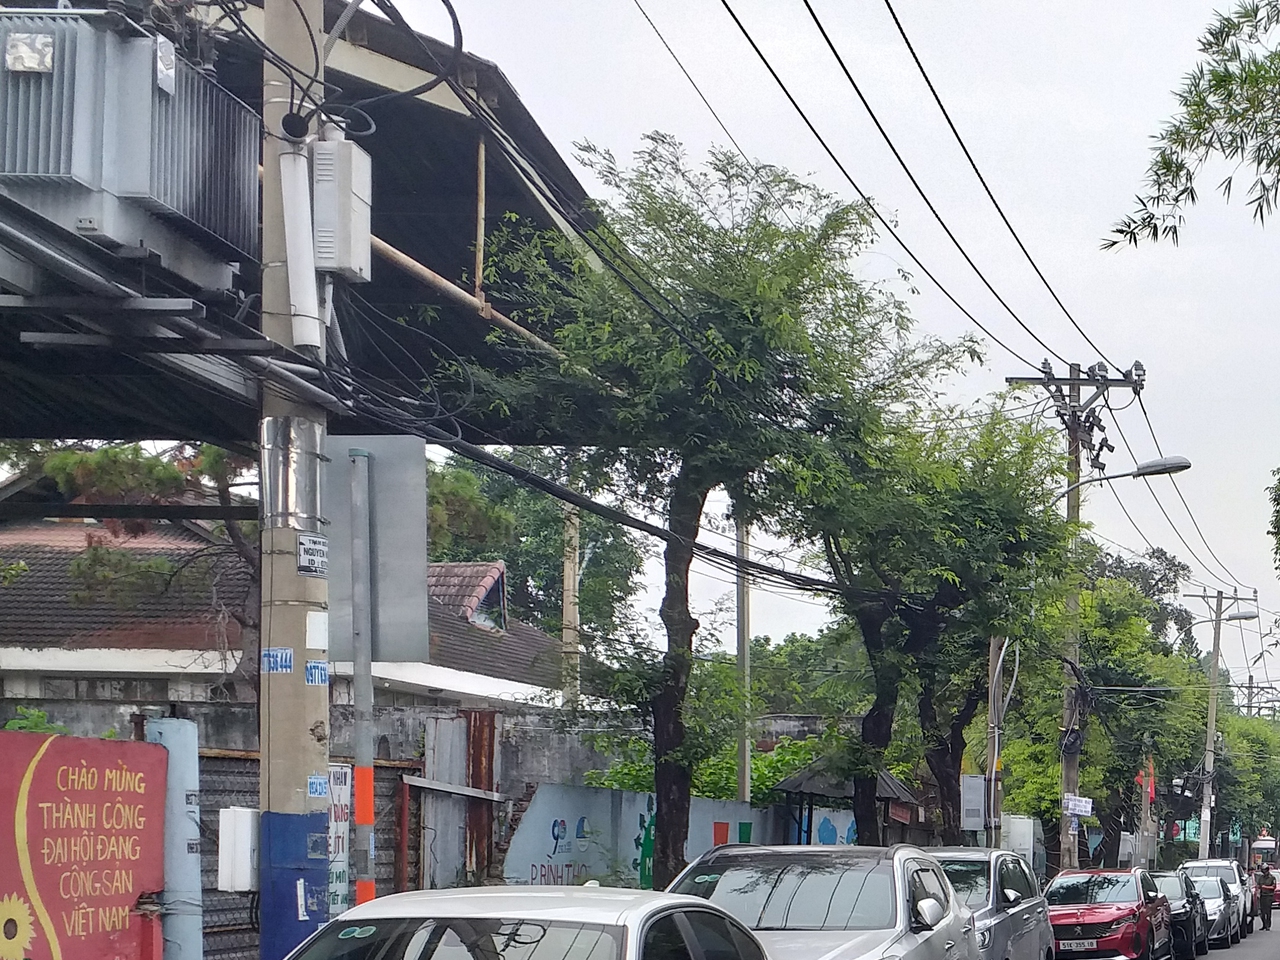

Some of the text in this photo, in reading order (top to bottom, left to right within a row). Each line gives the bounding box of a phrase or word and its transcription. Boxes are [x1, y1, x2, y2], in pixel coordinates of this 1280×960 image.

[56, 759, 98, 791] CHÀO
[38, 796, 96, 829] THÀNH
[41, 837, 67, 867] ĐẠI
[71, 831, 94, 865] HỘI
[60, 862, 133, 901] CỘNG SẢN
[62, 902, 129, 940] VIỆT NAM
